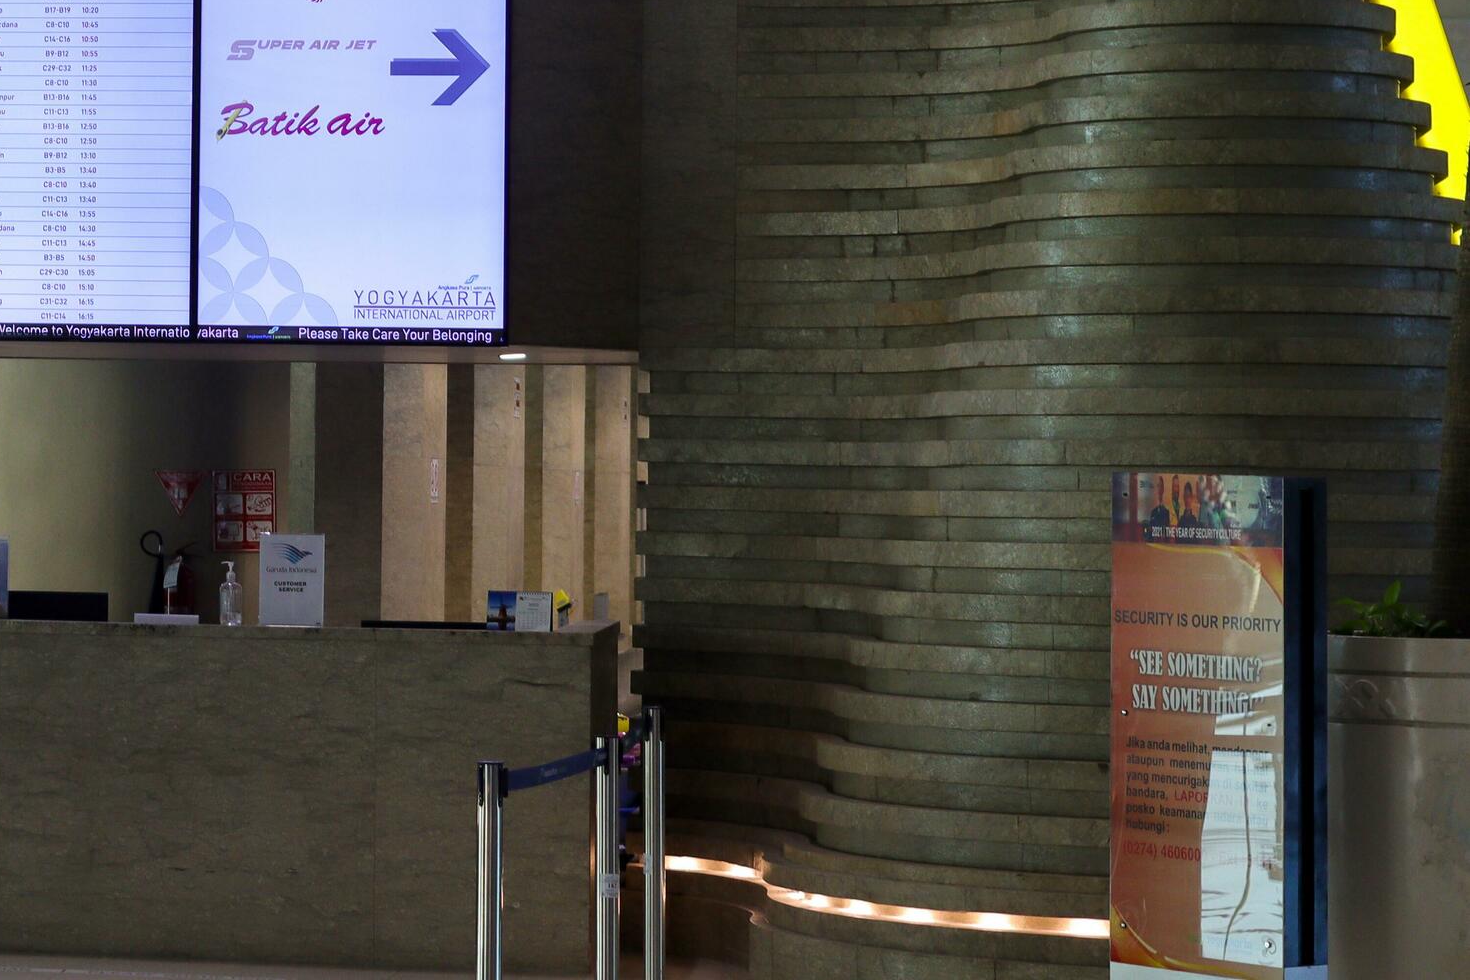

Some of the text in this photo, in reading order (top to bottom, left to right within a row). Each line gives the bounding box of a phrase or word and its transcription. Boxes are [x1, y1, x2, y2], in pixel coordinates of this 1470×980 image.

[226, 39, 377, 60] SUPER AIR JET
[216, 100, 385, 140] Batik air
[354, 290, 496, 306] YOGYAKARTA
[354, 309, 496, 321] INTERNATIONAL AIRPORT
[52, 324, 63, 336] to
[66, 324, 129, 338] Yogyakarta
[134, 324, 190, 337] Internatio
[298, 328, 338, 340] Please
[341, 328, 369, 340] Take
[372, 329, 399, 340] Care
[403, 329, 430, 341] Your
[433, 329, 492, 344] Belonging
[233, 473, 271, 482] CARA
[1166, 528, 1176, 537] THE
[1176, 529, 1188, 538] YEAR
[1115, 610, 1281, 633] SECURITY IS OUR PRIORITY
[1167, 653, 1263, 683] SOMETHING?
[1132, 684, 1157, 710] SAY
[1125, 737, 1146, 749] Jika
[1147, 739, 1170, 751] anda
[1172, 741, 1210, 755] melihat,
[1126, 754, 1164, 769] ataupun
[1126, 772, 1149, 784] yang
[1126, 787, 1168, 800] bandara,
[1125, 804, 1155, 816] posko
